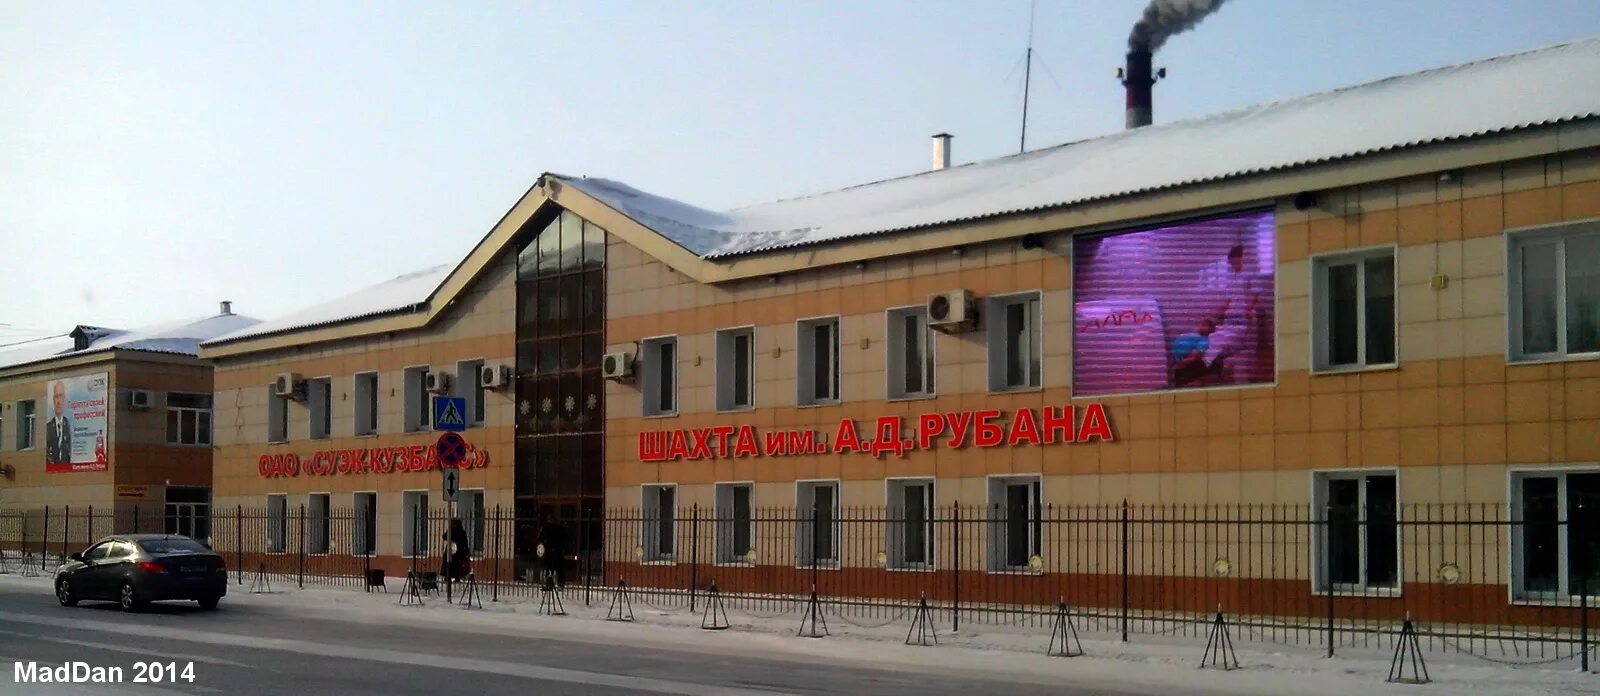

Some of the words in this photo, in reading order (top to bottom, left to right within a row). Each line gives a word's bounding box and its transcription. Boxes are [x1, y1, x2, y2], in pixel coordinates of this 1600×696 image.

[258, 453, 298, 478] ОАО
[302, 442, 488, 476] «СУЭК-КУЗБАС»
[638, 425, 758, 462] ШАХТА
[765, 430, 827, 456] им.
